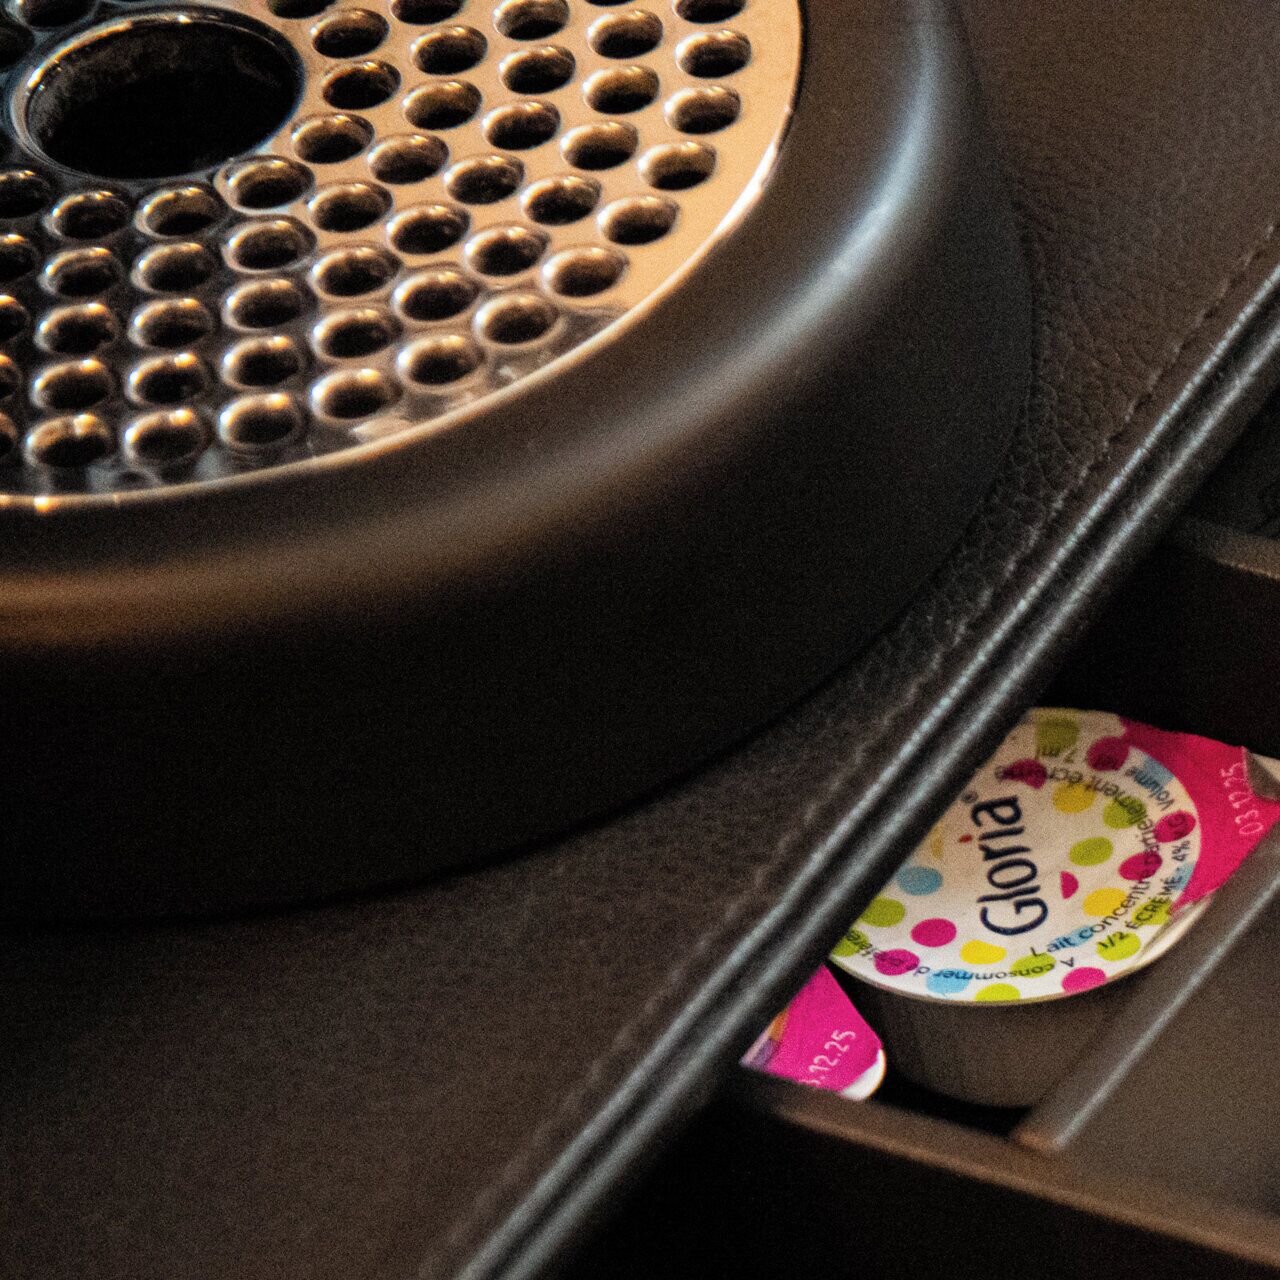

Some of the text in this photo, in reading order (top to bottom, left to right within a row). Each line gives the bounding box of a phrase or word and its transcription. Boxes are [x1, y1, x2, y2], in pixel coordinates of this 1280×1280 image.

[958, 795, 1050, 936] Gloria
[1030, 936, 1077, 958] Lait
[1097, 930, 1127, 951] 1/2
[933, 963, 1055, 981] consommer
